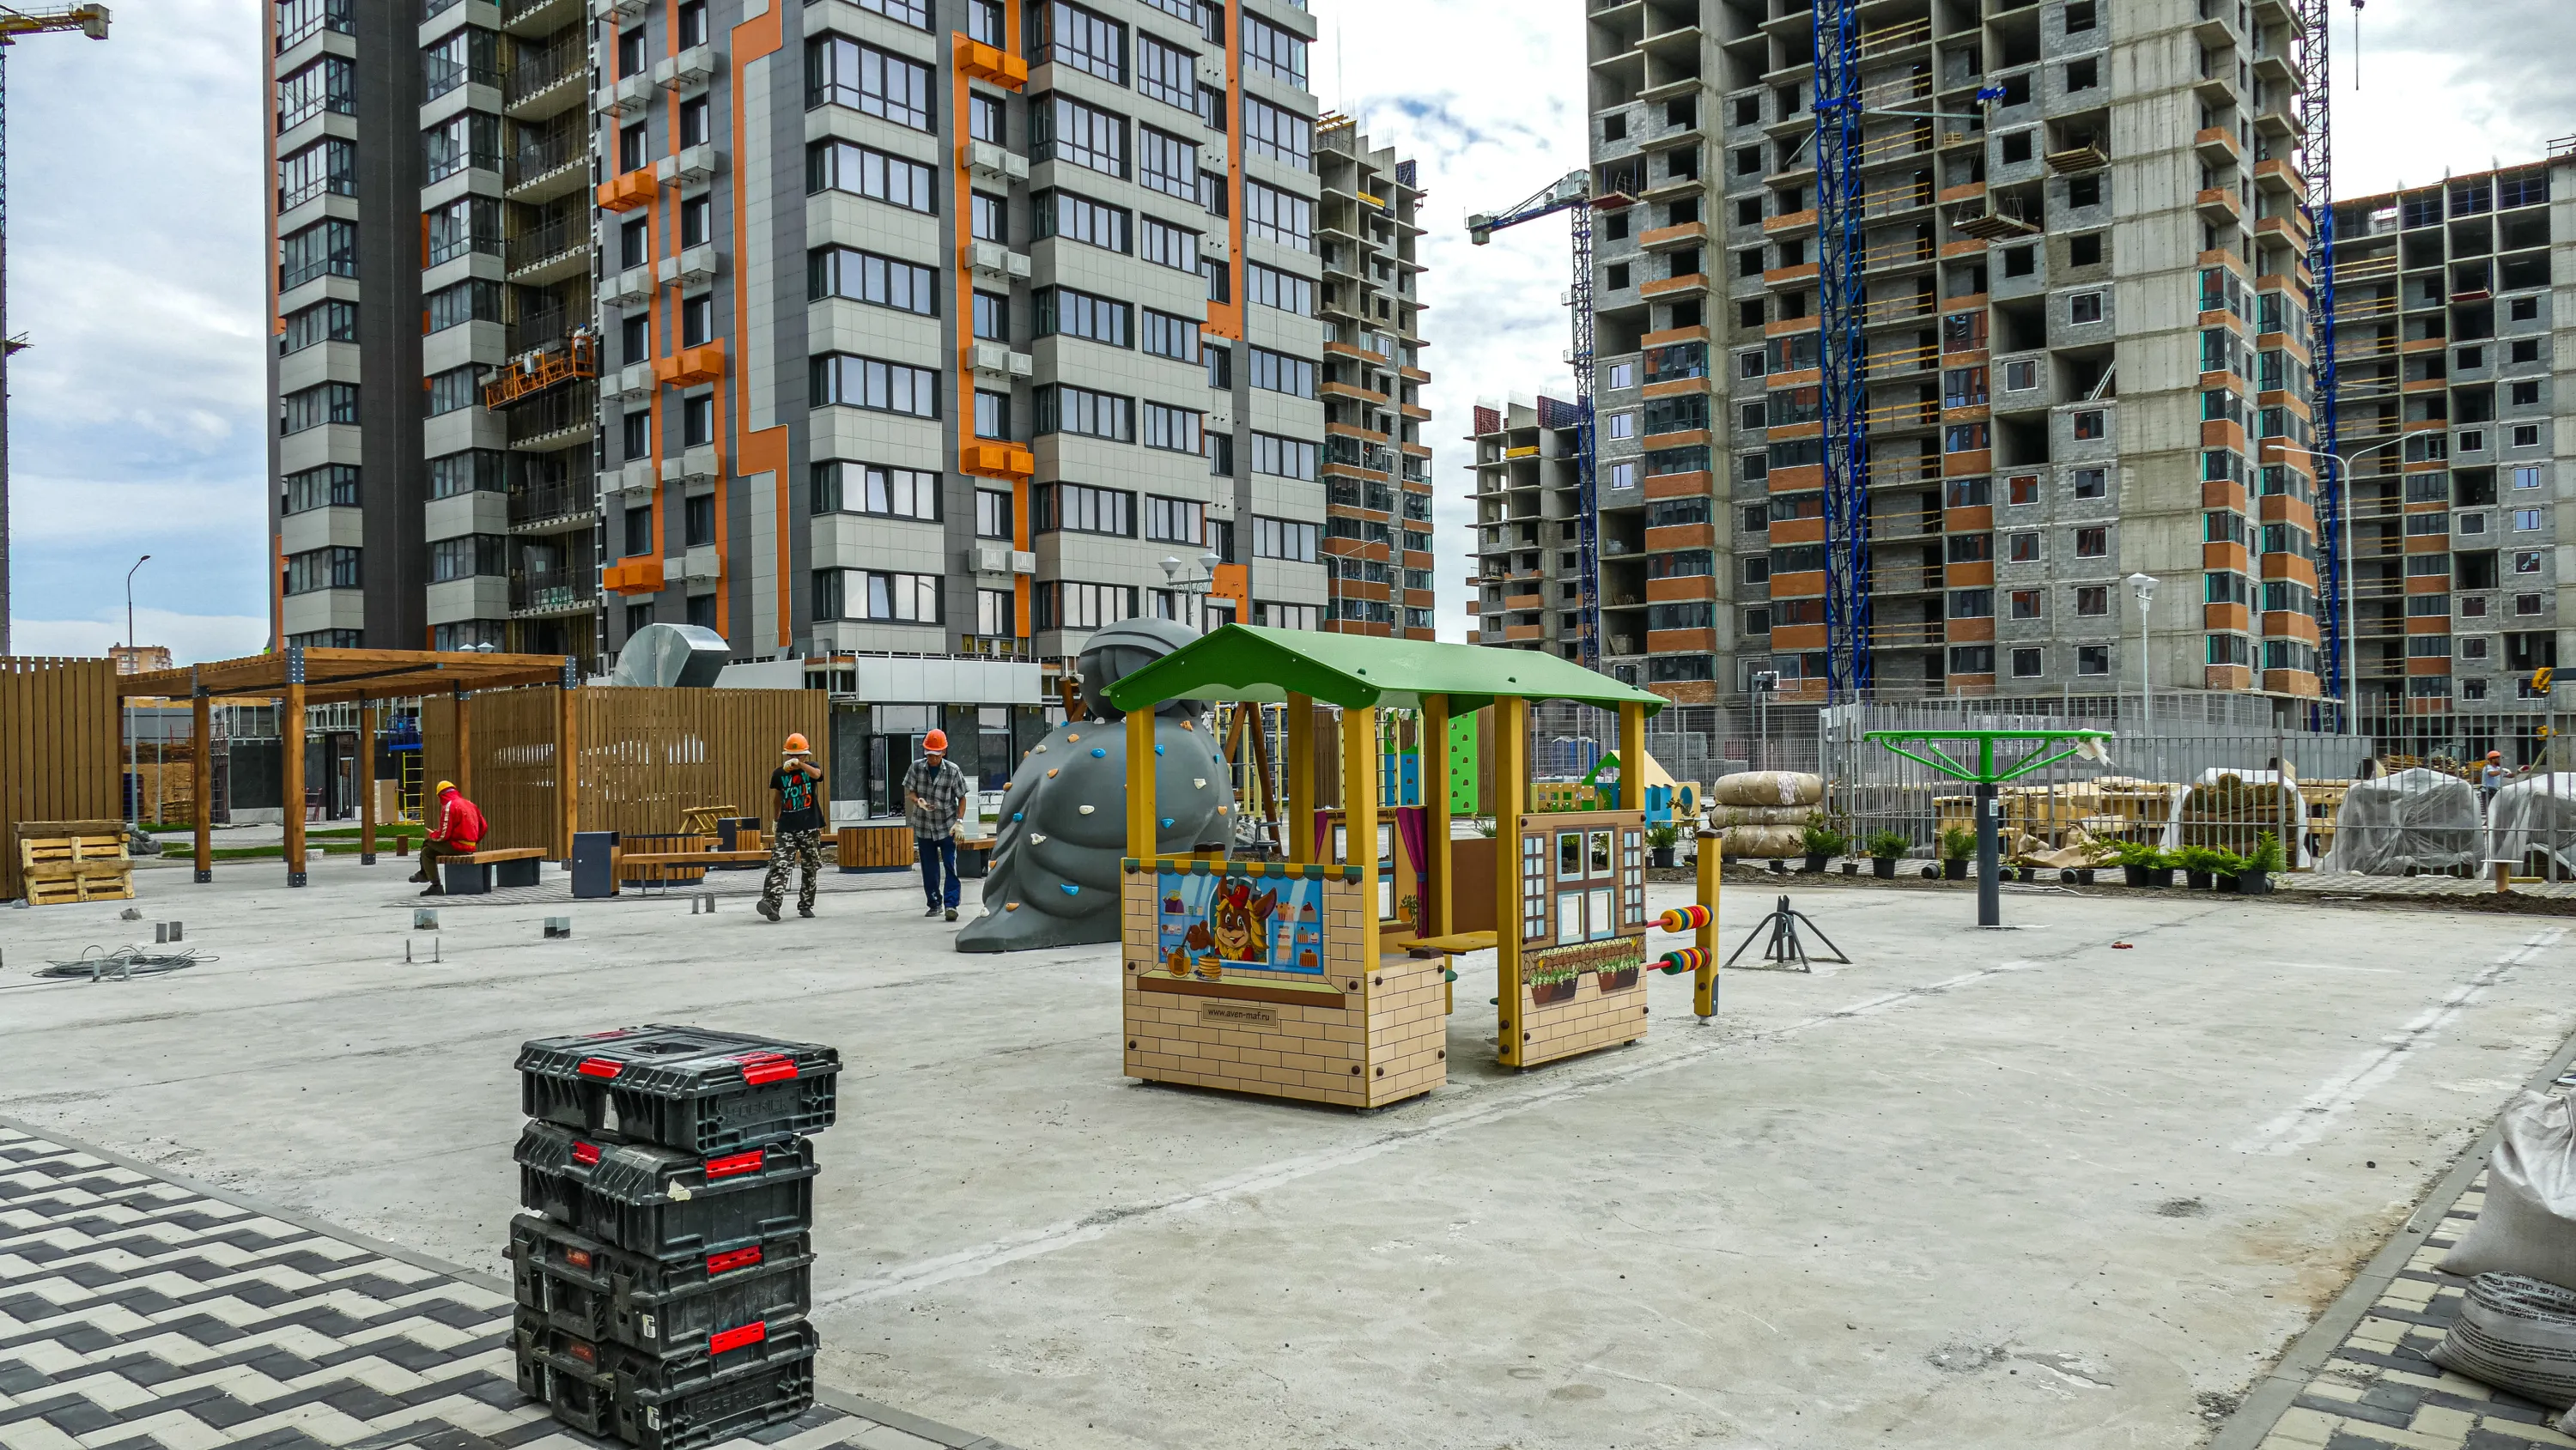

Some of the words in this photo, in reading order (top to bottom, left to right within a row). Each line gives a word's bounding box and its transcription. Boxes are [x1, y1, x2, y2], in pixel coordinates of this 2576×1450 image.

[783, 782, 811, 798] YOUR
[783, 794, 811, 810] MIND
[1207, 1009, 1270, 1021] www.aven-maf.ru
